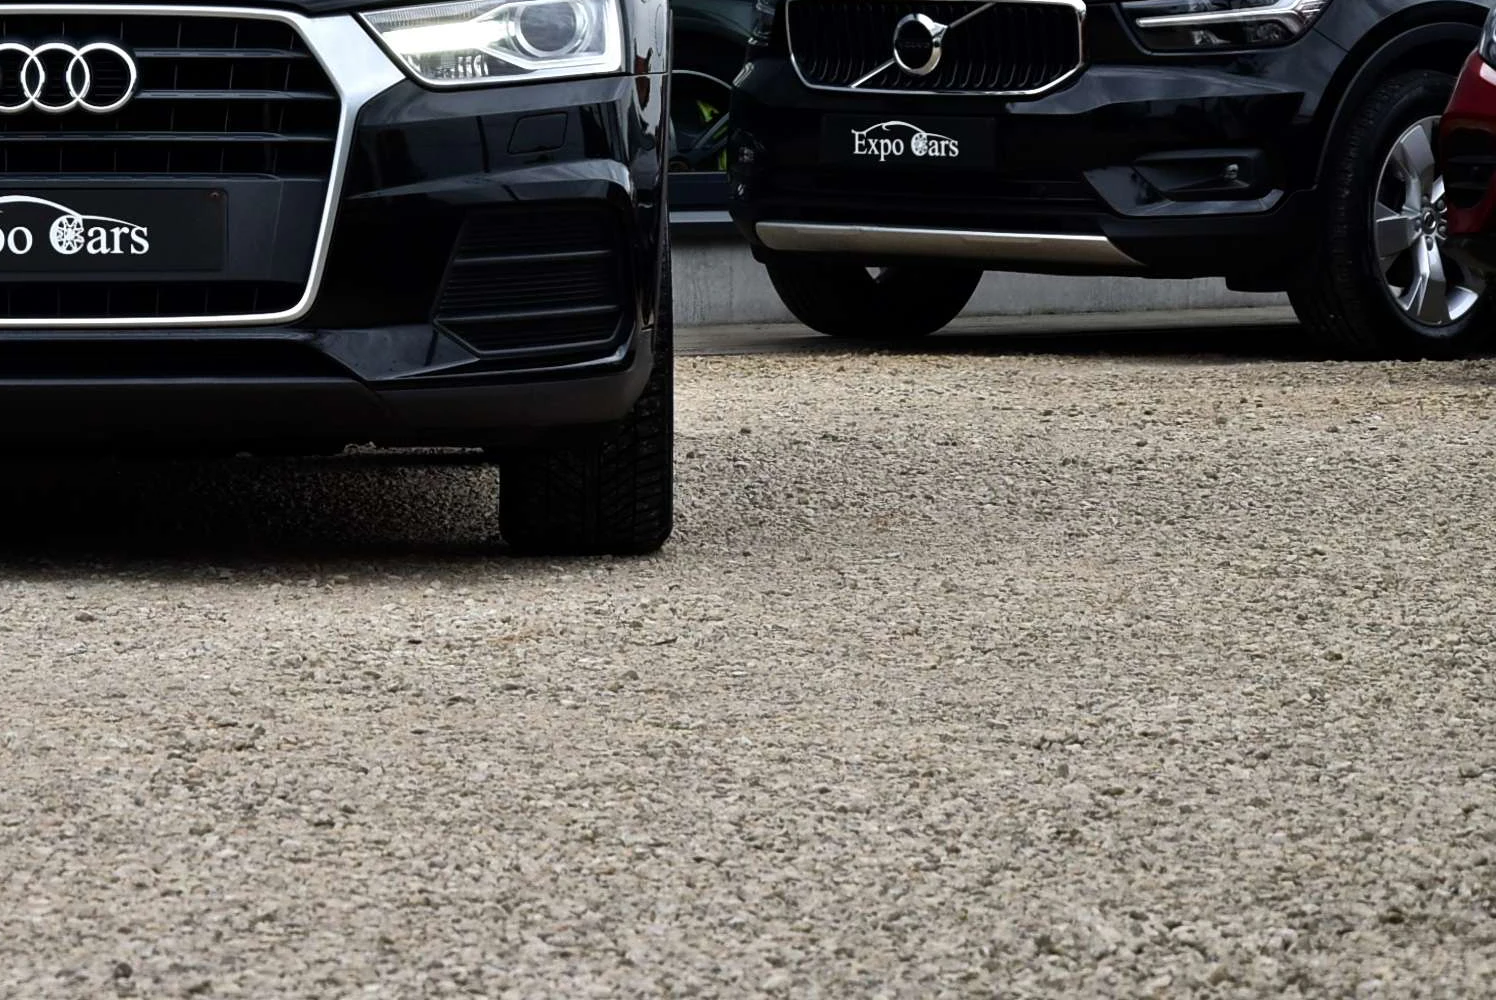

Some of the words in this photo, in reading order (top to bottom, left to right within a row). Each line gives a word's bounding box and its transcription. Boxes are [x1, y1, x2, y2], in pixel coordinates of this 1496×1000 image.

[851, 129, 904, 162] Expo
[910, 132, 959, 157] Cars
[49, 214, 150, 255] Cars
